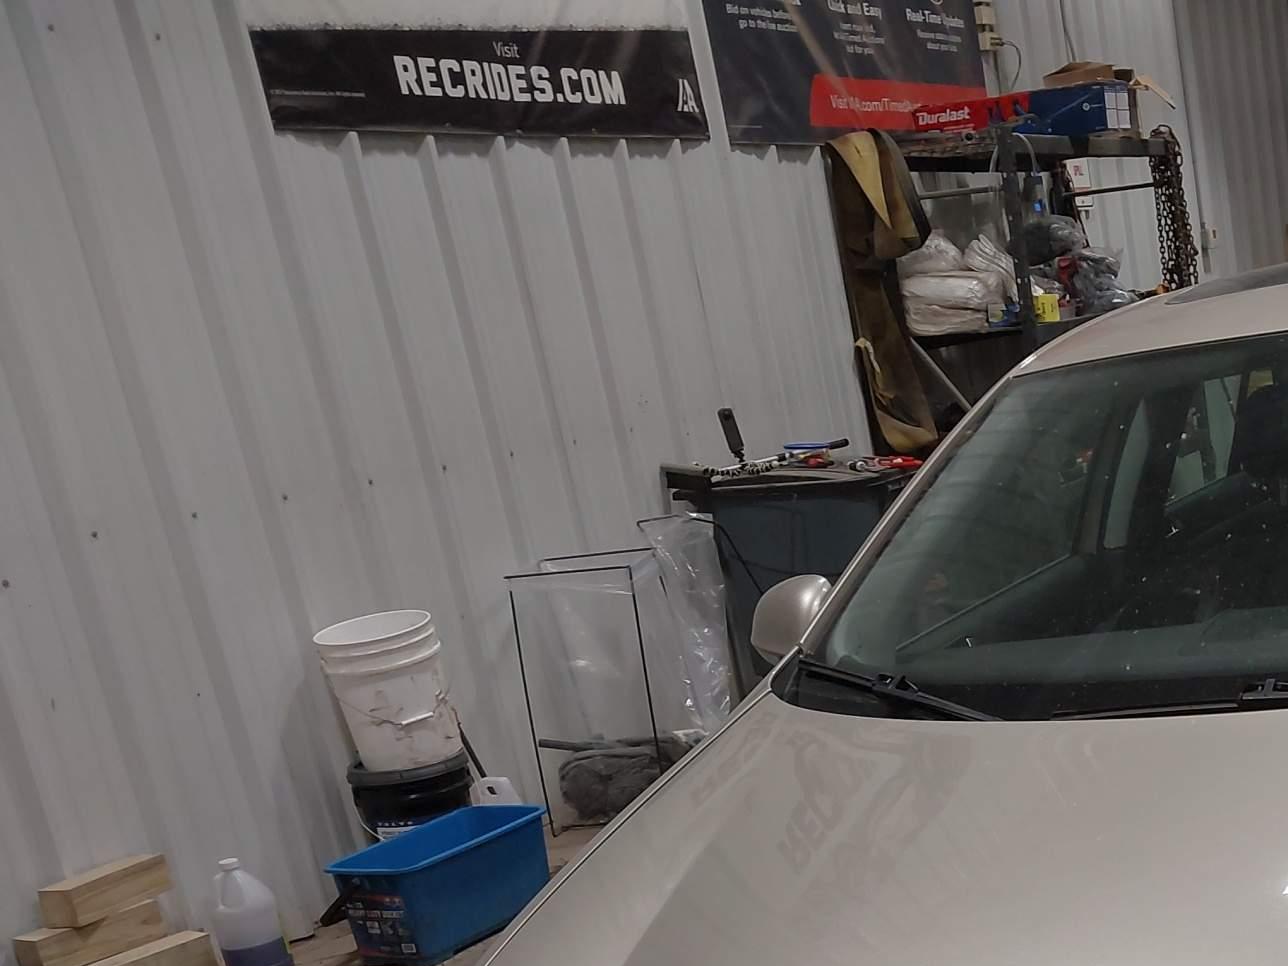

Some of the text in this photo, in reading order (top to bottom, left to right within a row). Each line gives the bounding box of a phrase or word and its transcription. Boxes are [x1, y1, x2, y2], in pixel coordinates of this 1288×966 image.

[492, 41, 520, 58] Visit
[393, 55, 626, 105] RECRIDES.COM
[916, 105, 971, 126] Duralast
